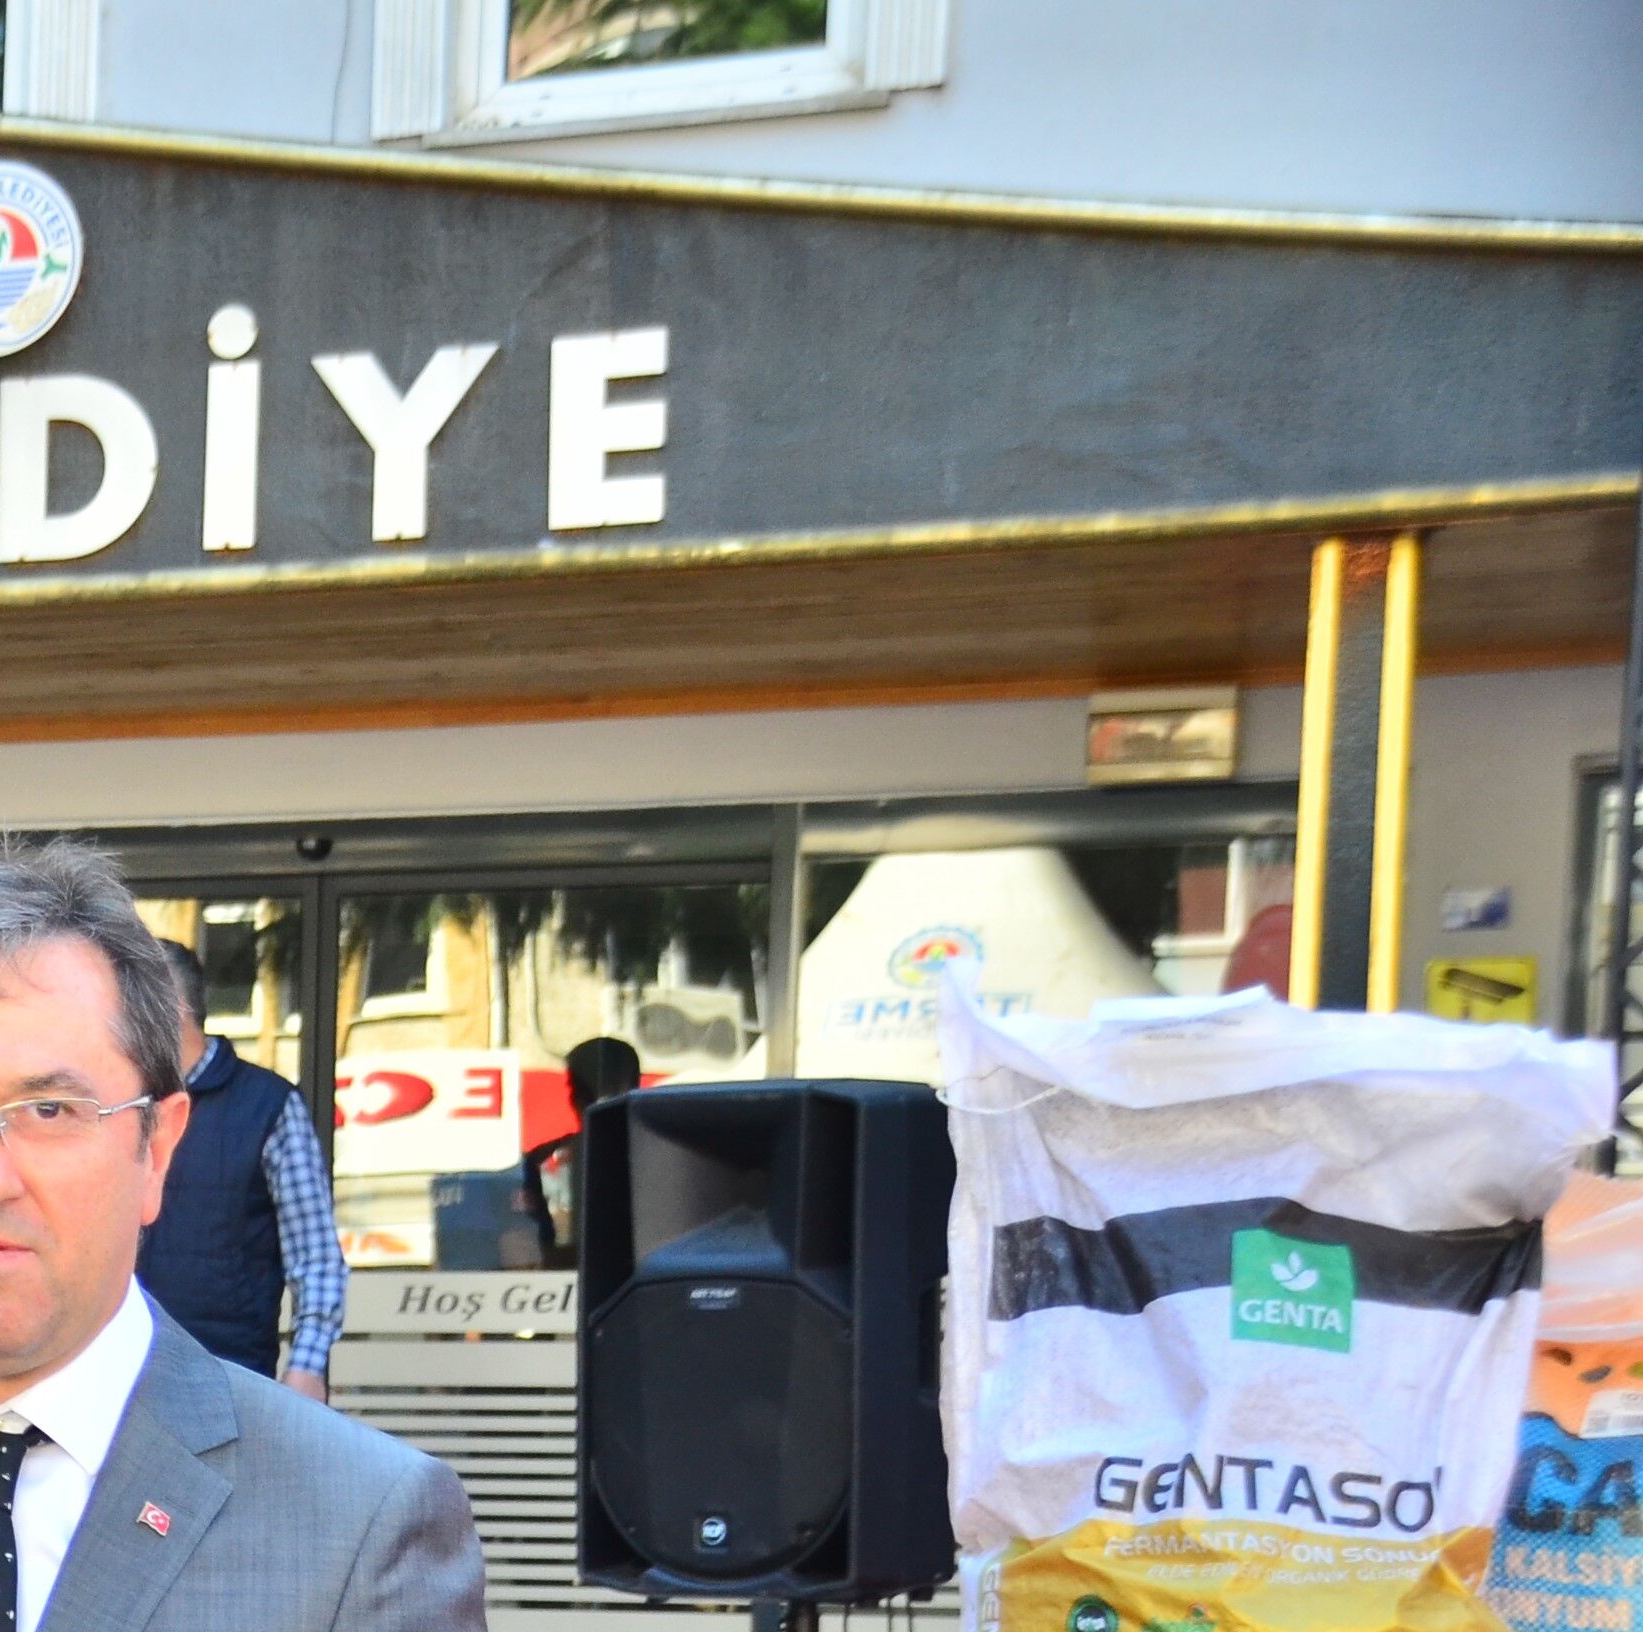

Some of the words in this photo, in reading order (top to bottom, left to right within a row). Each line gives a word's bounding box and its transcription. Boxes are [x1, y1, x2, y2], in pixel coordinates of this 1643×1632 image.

[397, 1284, 485, 1322] Hoş
[1238, 1299, 1343, 1334] GENTA
[1094, 1452, 1442, 1534] GENTASO
